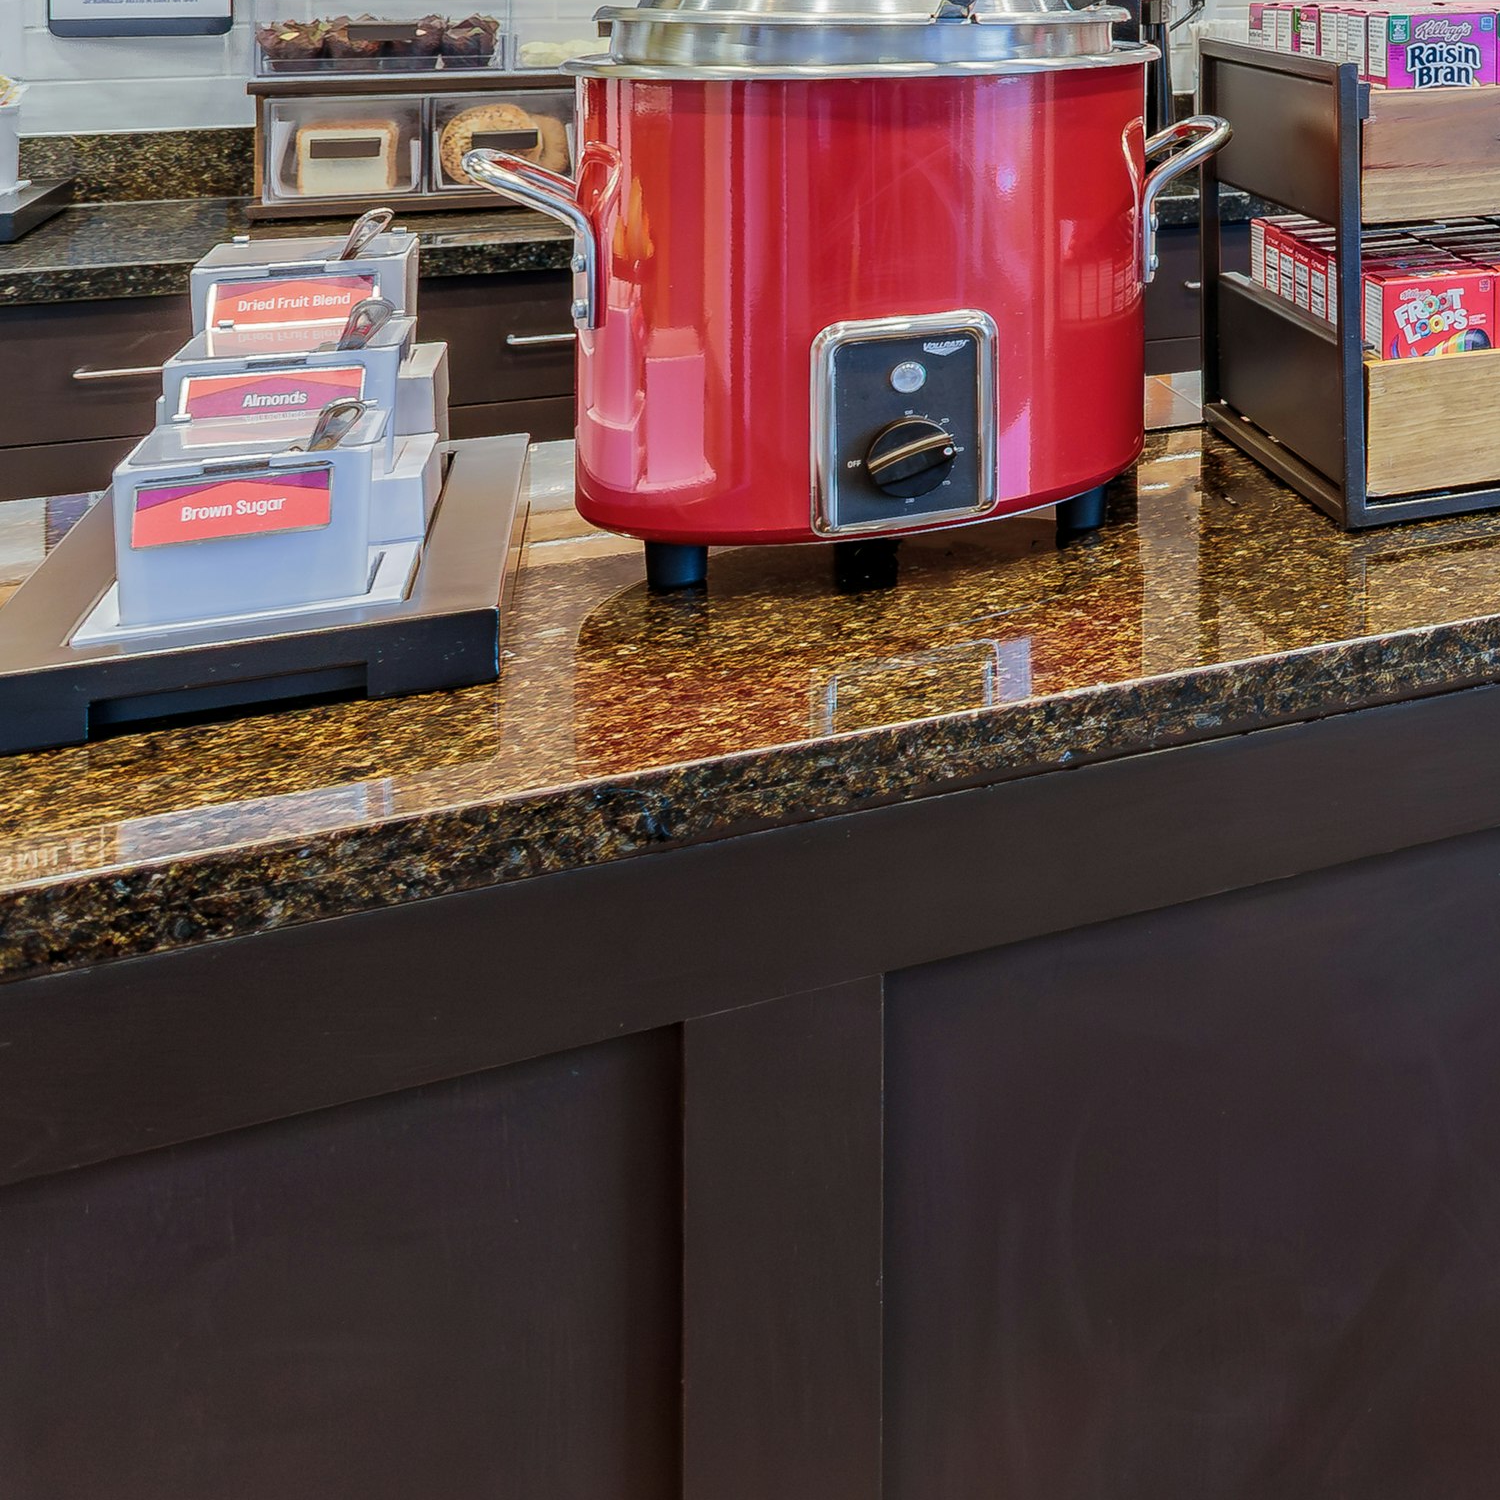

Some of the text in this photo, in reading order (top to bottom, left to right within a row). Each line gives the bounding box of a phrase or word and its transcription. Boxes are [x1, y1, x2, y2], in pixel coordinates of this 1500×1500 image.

[1415, 19, 1472, 41] Kellogg's
[1408, 44, 1479, 71] Raisin
[1418, 66, 1471, 87] Bran
[237, 293, 351, 312] Dried Fruit Blend
[1394, 288, 1464, 328] FROOT
[1403, 309, 1468, 344] LOOPS
[242, 390, 307, 408] Almonds
[847, 460, 861, 468] OFF
[181, 498, 287, 522] Brown Sugar
